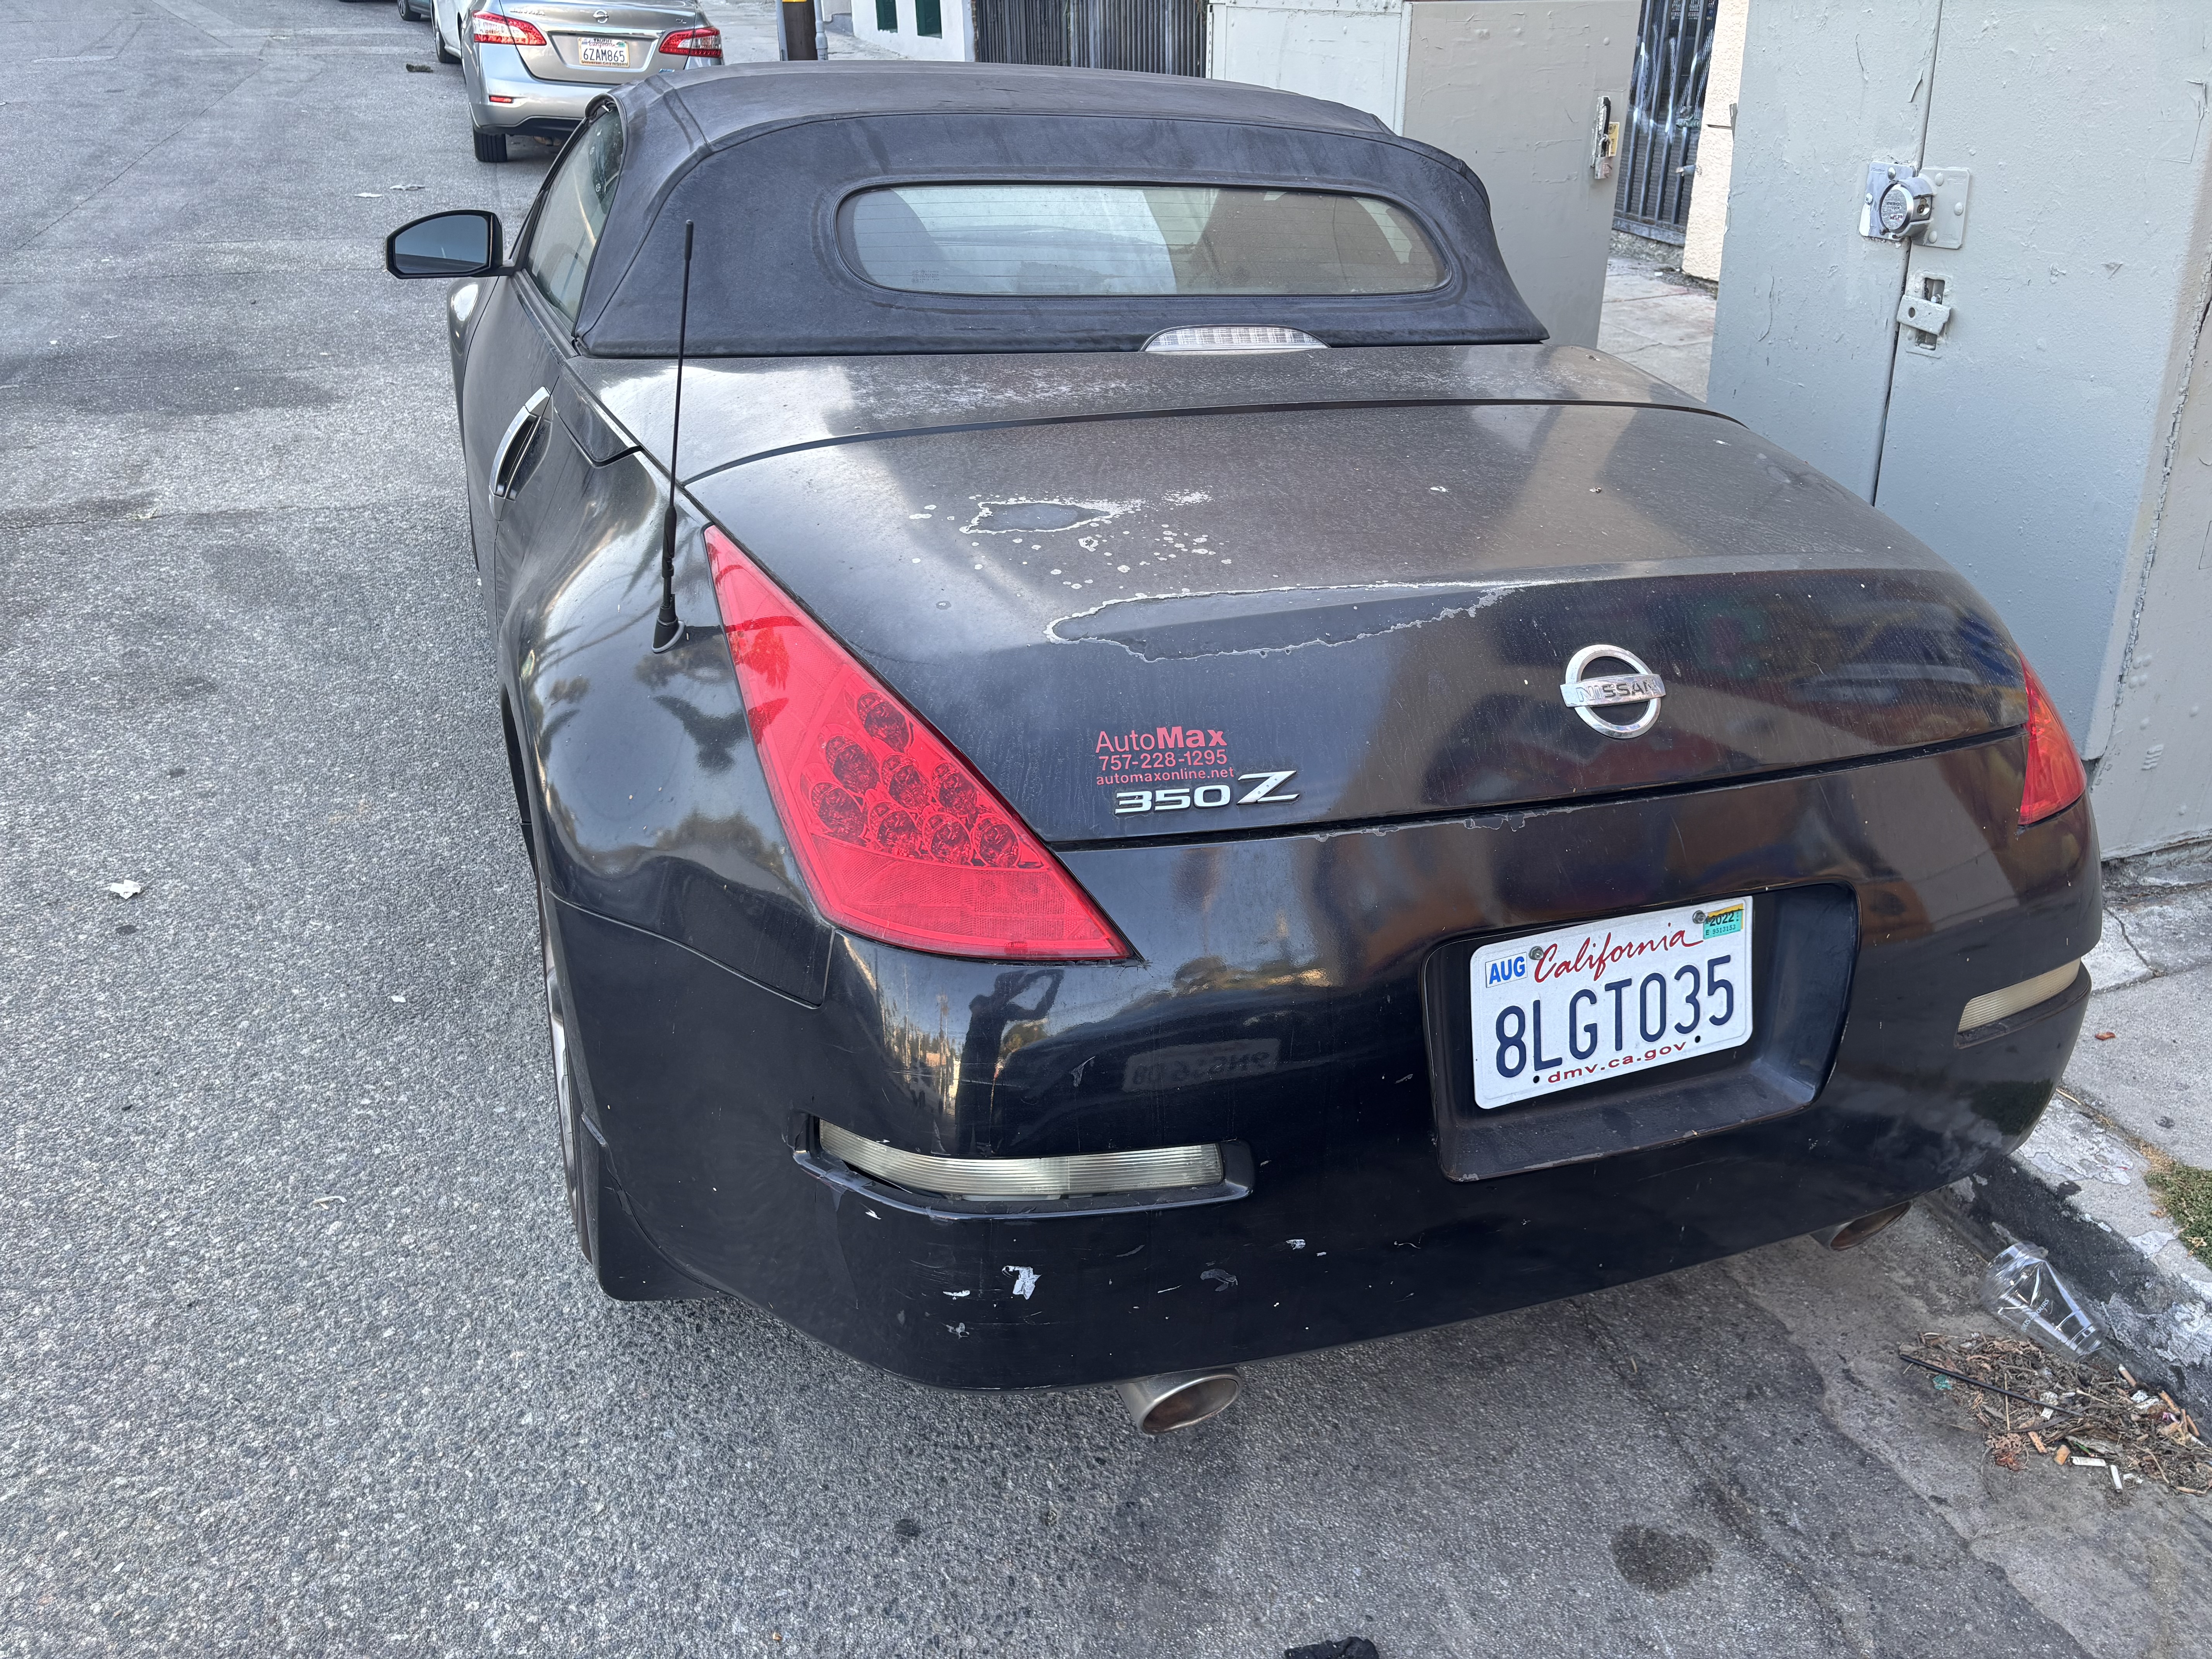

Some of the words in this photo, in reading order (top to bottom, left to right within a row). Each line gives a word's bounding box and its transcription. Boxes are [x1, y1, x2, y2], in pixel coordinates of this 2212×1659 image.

[583, 48, 625, 62] 6ZAM865
[1576, 680, 1656, 702] NISSAN
[1096, 726, 1227, 753] AutoMax
[1099, 749, 1227, 771] 757-228-1295
[1096, 767, 1234, 785] automaxonline.net
[1710, 912, 1734, 927] 2022
[1712, 924, 1736, 934] 9513153
[1535, 922, 1704, 983] California
[1489, 957, 1525, 985] AUG
[1496, 955, 1734, 1078] 8LGT035
[1548, 1041, 1686, 1083] dmv.ca.gov
